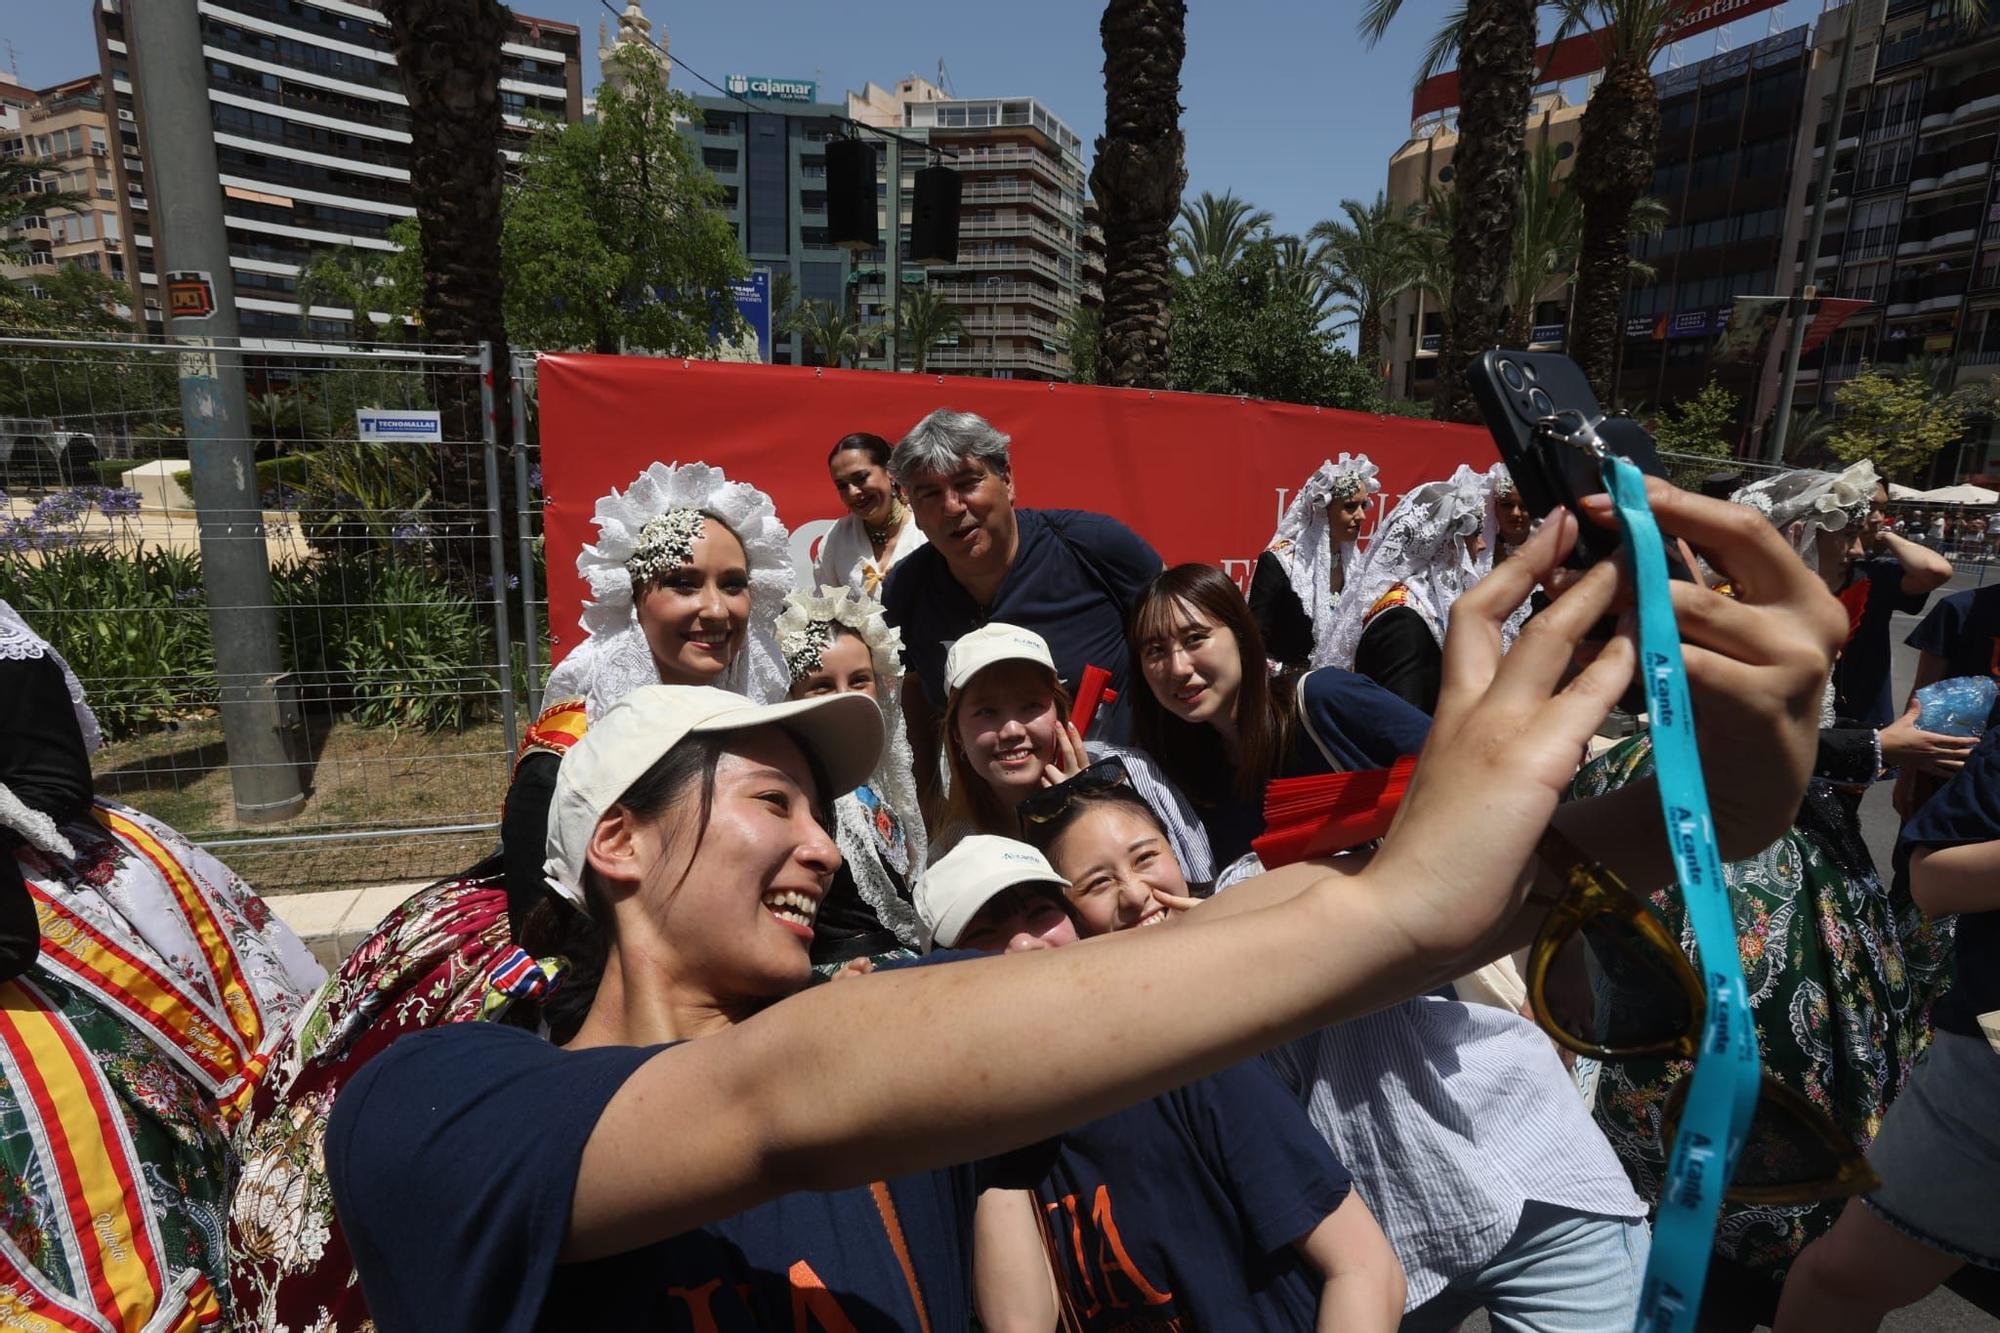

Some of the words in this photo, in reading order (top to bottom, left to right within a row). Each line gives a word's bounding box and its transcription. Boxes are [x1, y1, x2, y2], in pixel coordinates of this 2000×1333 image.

[750, 79, 811, 96] cajamar
[378, 420, 436, 428] TECNOMALLAS
[1653, 651, 1673, 727] Alicante
[1677, 805, 1702, 886] Alicante
